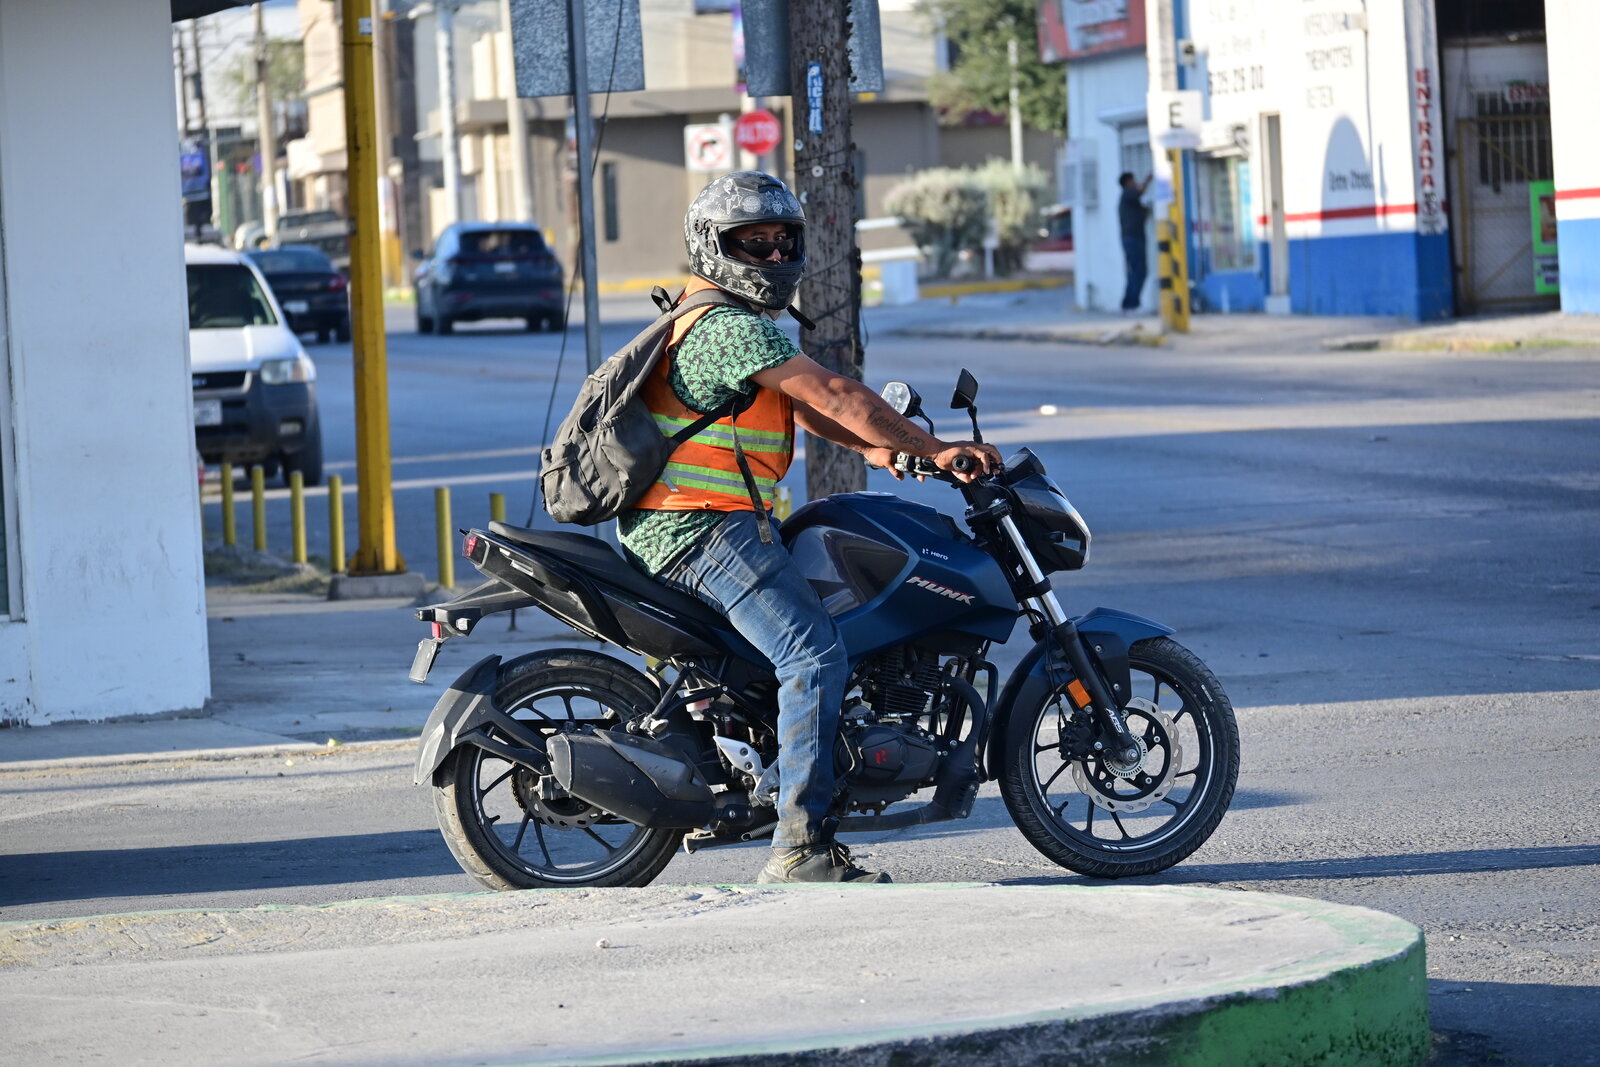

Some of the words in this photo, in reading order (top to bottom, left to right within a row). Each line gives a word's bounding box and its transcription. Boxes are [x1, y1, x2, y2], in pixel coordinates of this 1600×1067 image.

[1169, 102, 1183, 128] E
[1415, 69, 1434, 187] ENTRADA
[737, 121, 780, 144] ALTO
[930, 551, 949, 561] Hero
[906, 575, 976, 607] HUNK
